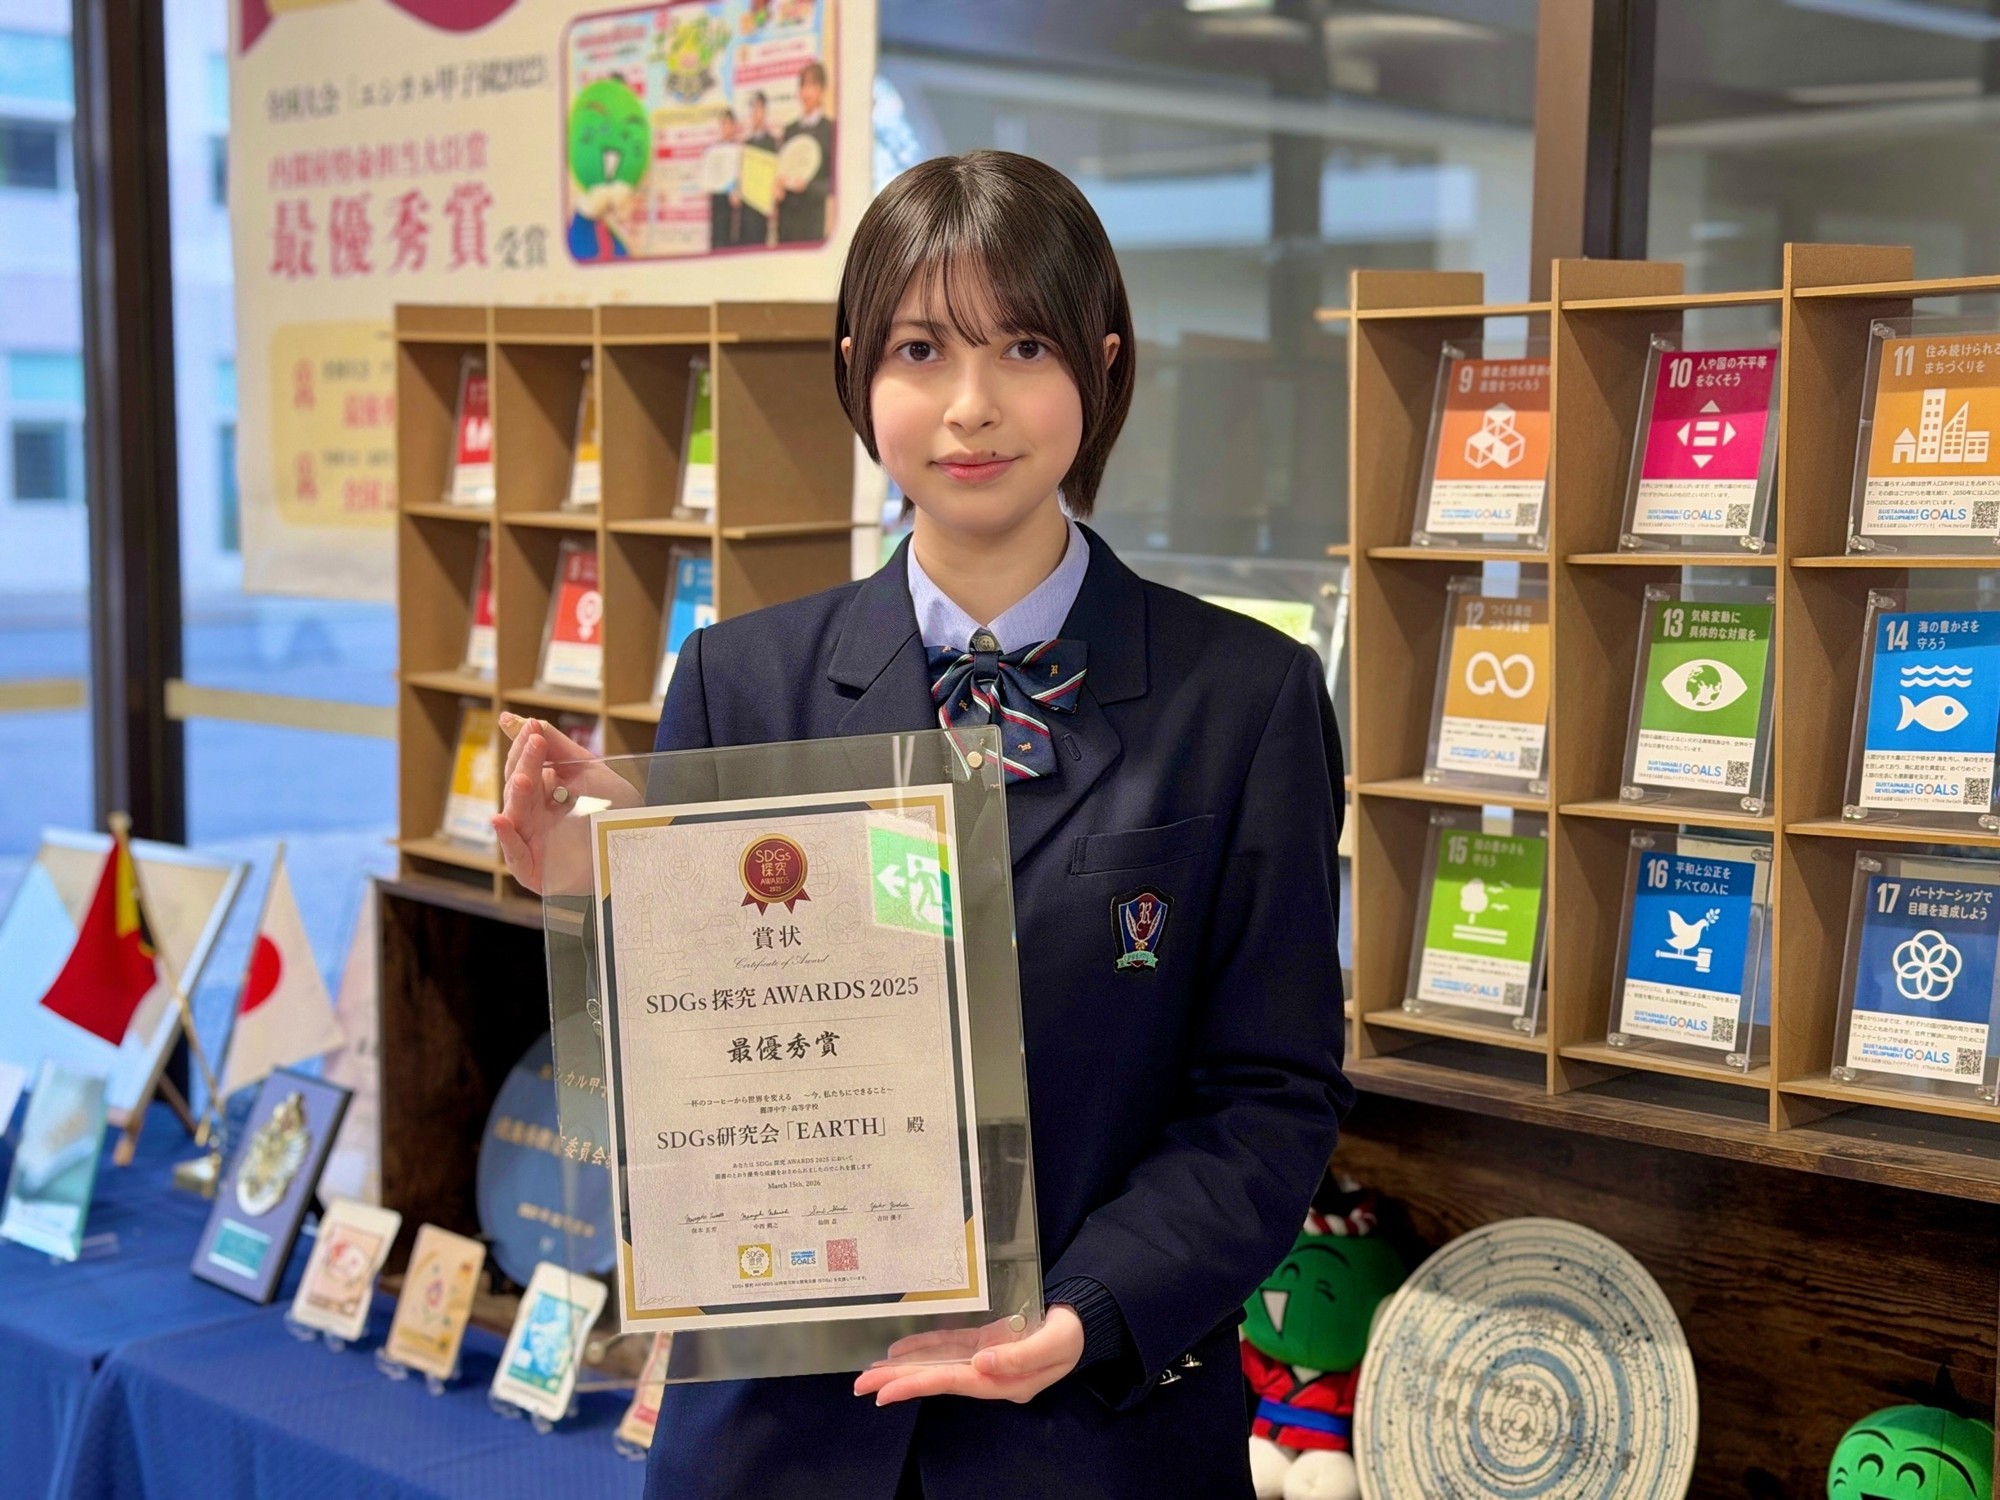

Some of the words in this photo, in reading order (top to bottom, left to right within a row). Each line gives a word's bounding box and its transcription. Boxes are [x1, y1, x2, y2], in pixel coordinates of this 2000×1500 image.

[270, 180, 492, 280] 最優秀賞
[1697, 355, 1768, 370] 人や国の不平等
[1894, 345, 1915, 376] 11
[1924, 360, 1985, 375] まちづくりを
[1458, 365, 1474, 394] 9
[1669, 358, 1693, 388] 10
[1696, 372, 1741, 387] をなくそう
[1683, 509, 1722, 520] GOALS
[1920, 508, 1967, 521] GOALS
[1465, 602, 1485, 631] 12
[1663, 607, 1685, 638] 13
[1691, 609, 1741, 623] 気候変動に
[1689, 626, 1756, 641] 具体的な対策を
[1918, 619, 1980, 633] 海の豊かさを
[1886, 620, 1909, 651] 14
[1917, 637, 1946, 650] 守ろう
[1647, 766, 1682, 774] DEVELOPMENT
[1648, 760, 1682, 768] SUSTAINABLE
[1683, 763, 1722, 777] GOALS
[1915, 783, 1959, 796] GOALS
[755, 848, 791, 863] SDGs
[1448, 836, 1469, 865] 15
[761, 861, 787, 877] 探究
[1647, 859, 1669, 889] 16
[1675, 861, 1731, 879] 平和と公正を
[760, 876, 790, 886] AWARDS
[1674, 877, 1729, 896] すべての人に
[1877, 883, 1901, 914] 17
[1909, 886, 1993, 904] パートナーシップで
[1908, 902, 1988, 921] 目標を達成しよう
[752, 925, 801, 950] 賞状
[734, 956, 779, 972] Certificate
[791, 952, 830, 966] Award
[646, 993, 707, 1014] SDGs
[712, 988, 757, 1011] 探究
[762, 979, 866, 1006] AWARDS
[870, 976, 919, 998] 2025
[1633, 1015, 1668, 1025] DEVELOPMENT
[1634, 1010, 1669, 1019] SUSTAINABLE
[1669, 1015, 1708, 1032] GOALS
[727, 1030, 841, 1064] 最優秀賞
[1862, 1049, 1903, 1058] DEVELOPMENT
[1863, 1043, 1903, 1052] SUSTAINABLE
[1904, 1048, 1950, 1064] GOALS
[684, 1093, 792, 1107] 一杯のコーヒーから世界を変える
[657, 1116, 886, 1150] SDGs研究会「EARTH」
[907, 1115, 925, 1134] 殿
[756, 1160, 773, 1168] SDGs
[787, 1157, 814, 1165] AWARDS
[767, 1182, 788, 1190] March
[789, 1180, 805, 1188] 15th,
[791, 1258, 816, 1266] GOALS
